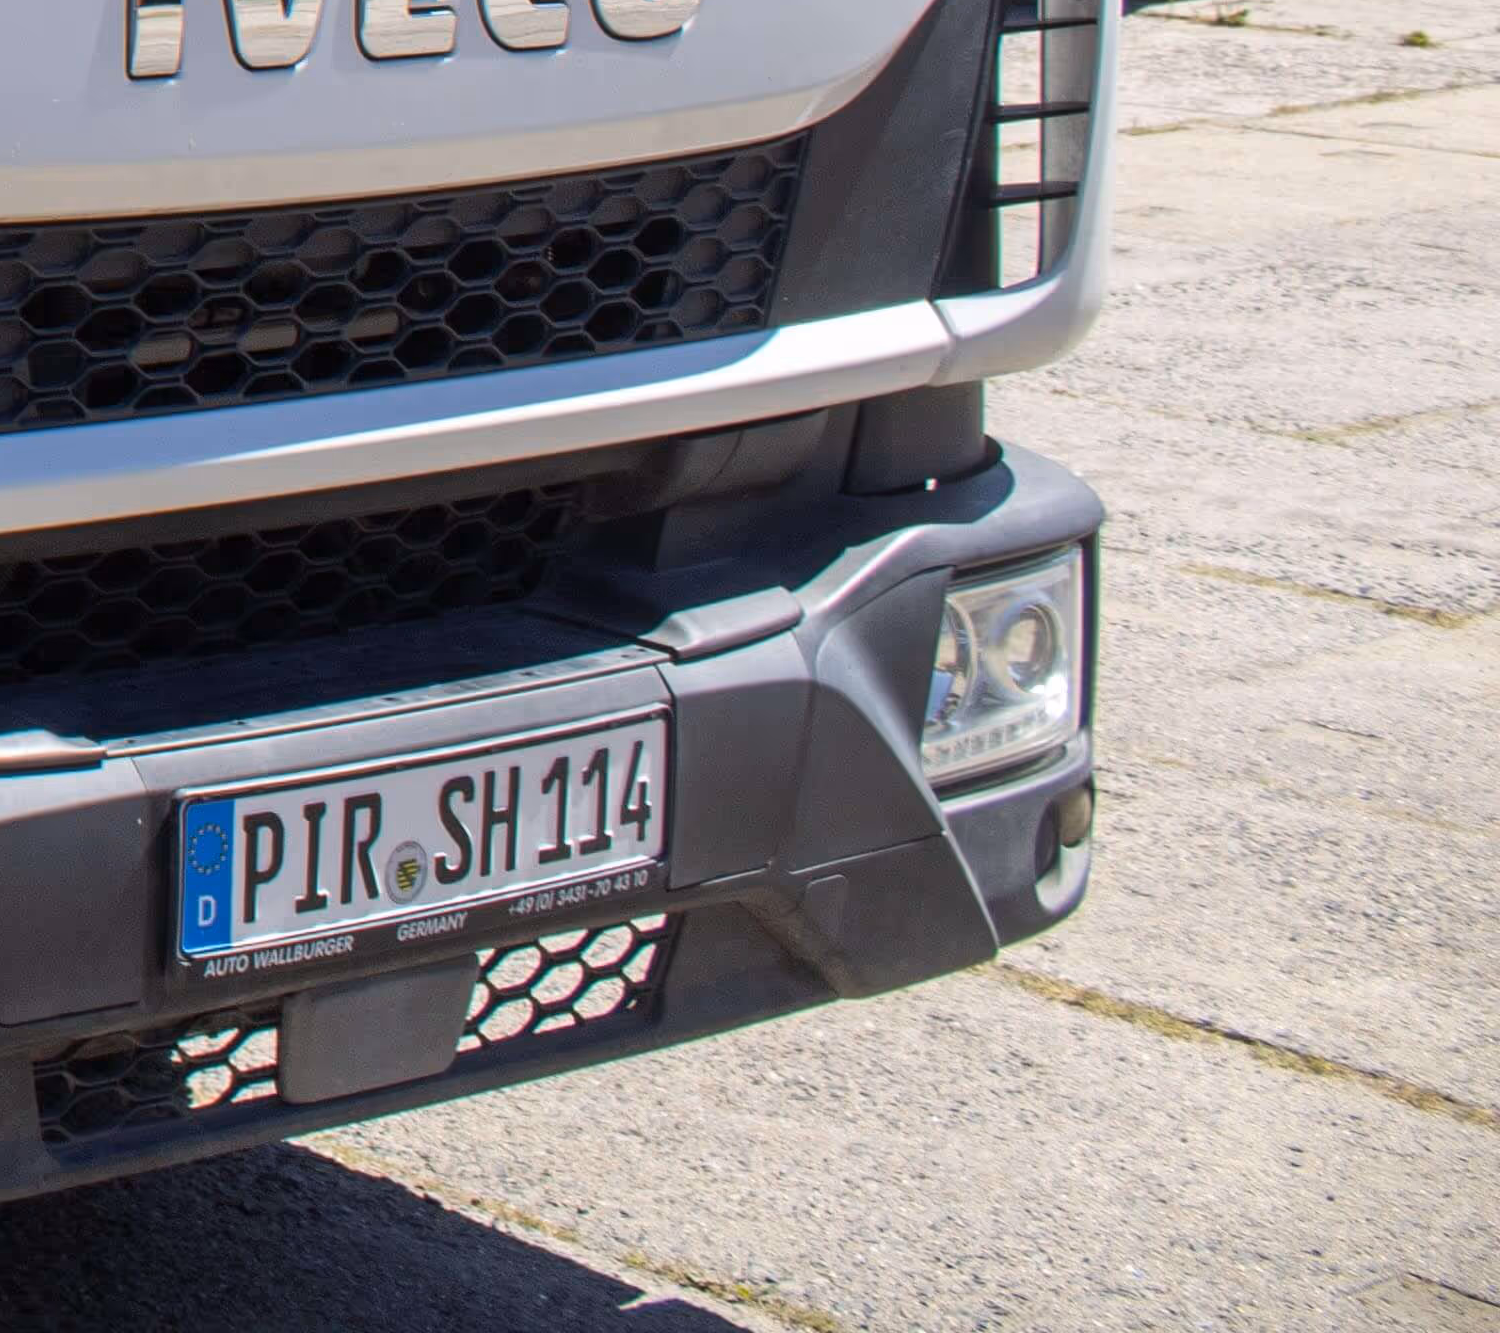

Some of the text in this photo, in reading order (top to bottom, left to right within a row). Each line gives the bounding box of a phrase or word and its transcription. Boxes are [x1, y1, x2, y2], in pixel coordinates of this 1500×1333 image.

[243, 740, 653, 924] PIR SH 114
[197, 895, 217, 927] D
[508, 896, 534, 915] +49
[613, 873, 630, 893] 43
[633, 869, 649, 887] 10
[203, 912, 468, 979] AUTO WALLBURGER GERMANY
